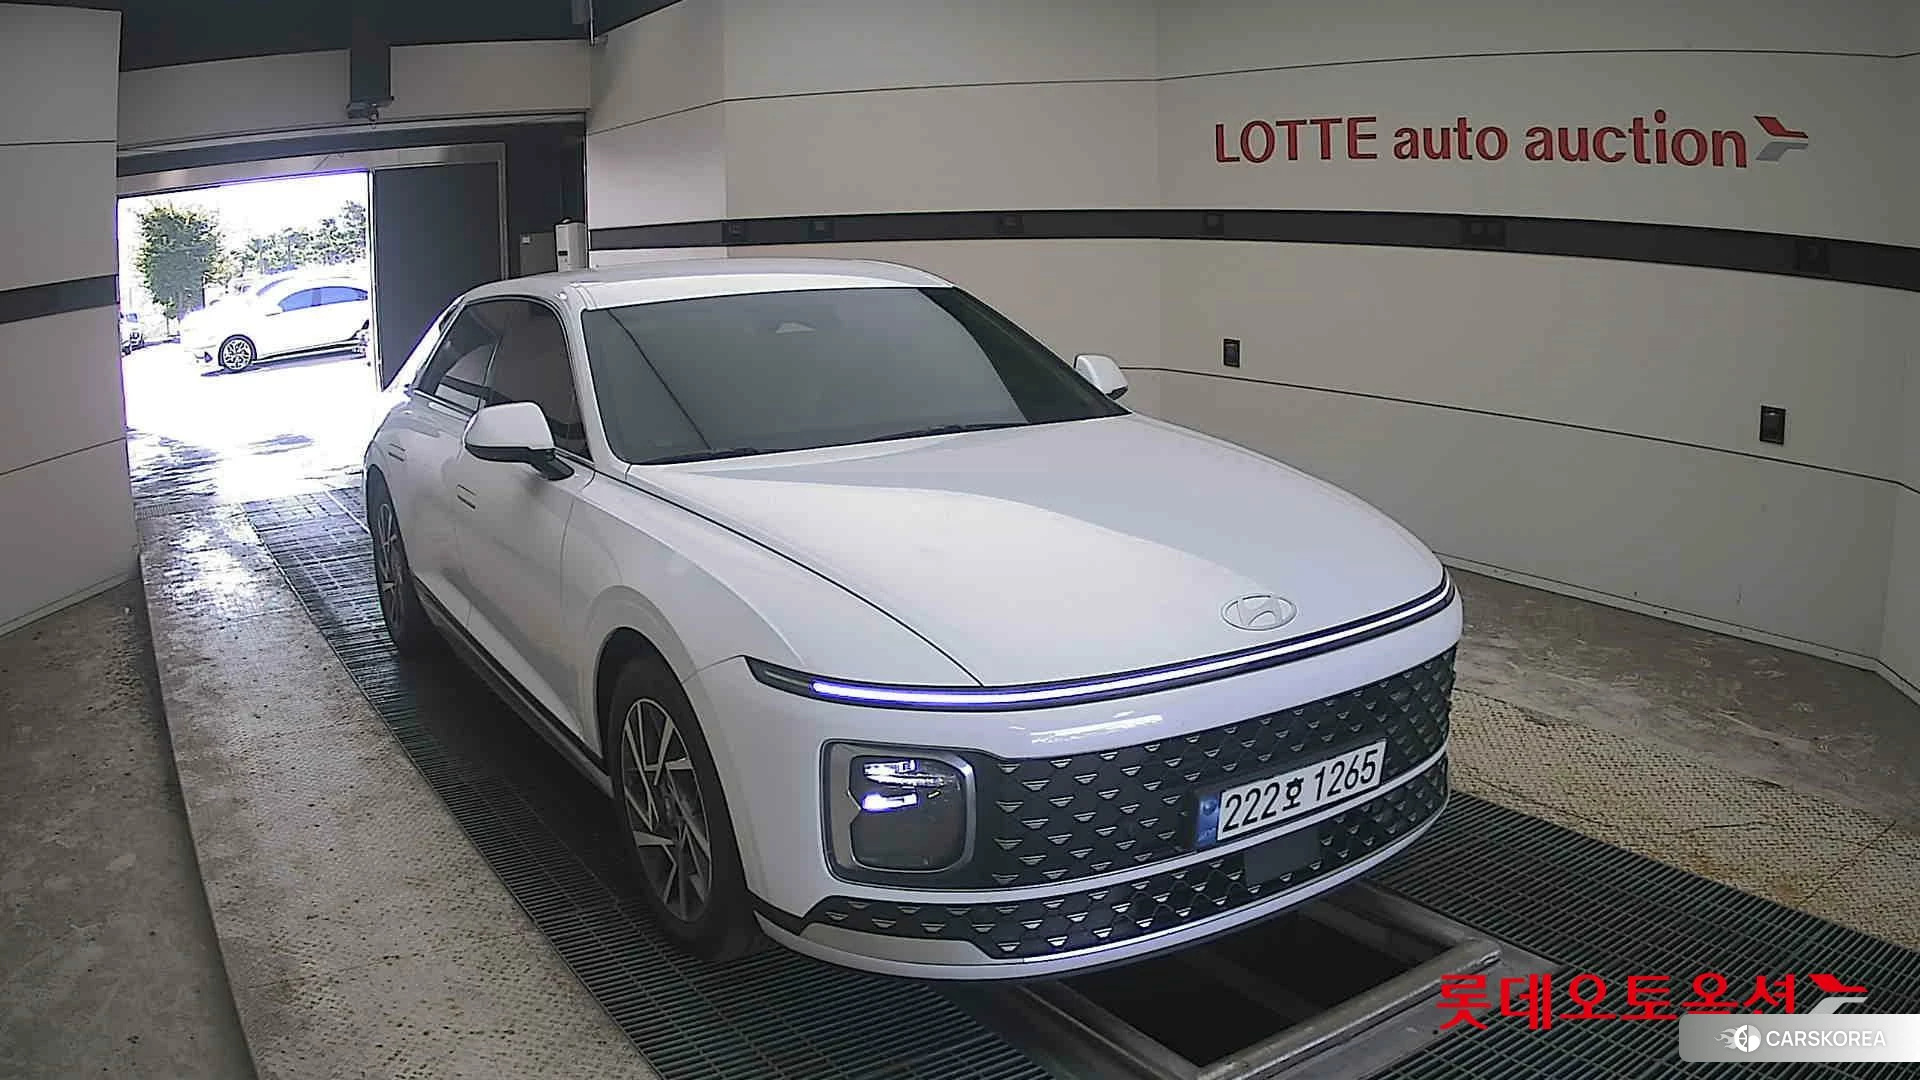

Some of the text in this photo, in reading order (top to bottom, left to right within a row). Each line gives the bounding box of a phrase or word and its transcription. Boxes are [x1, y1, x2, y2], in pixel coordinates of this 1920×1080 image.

[1215, 109, 1748, 168] LOTTE auto auction
[1222, 750, 1378, 832] 222호 1265
